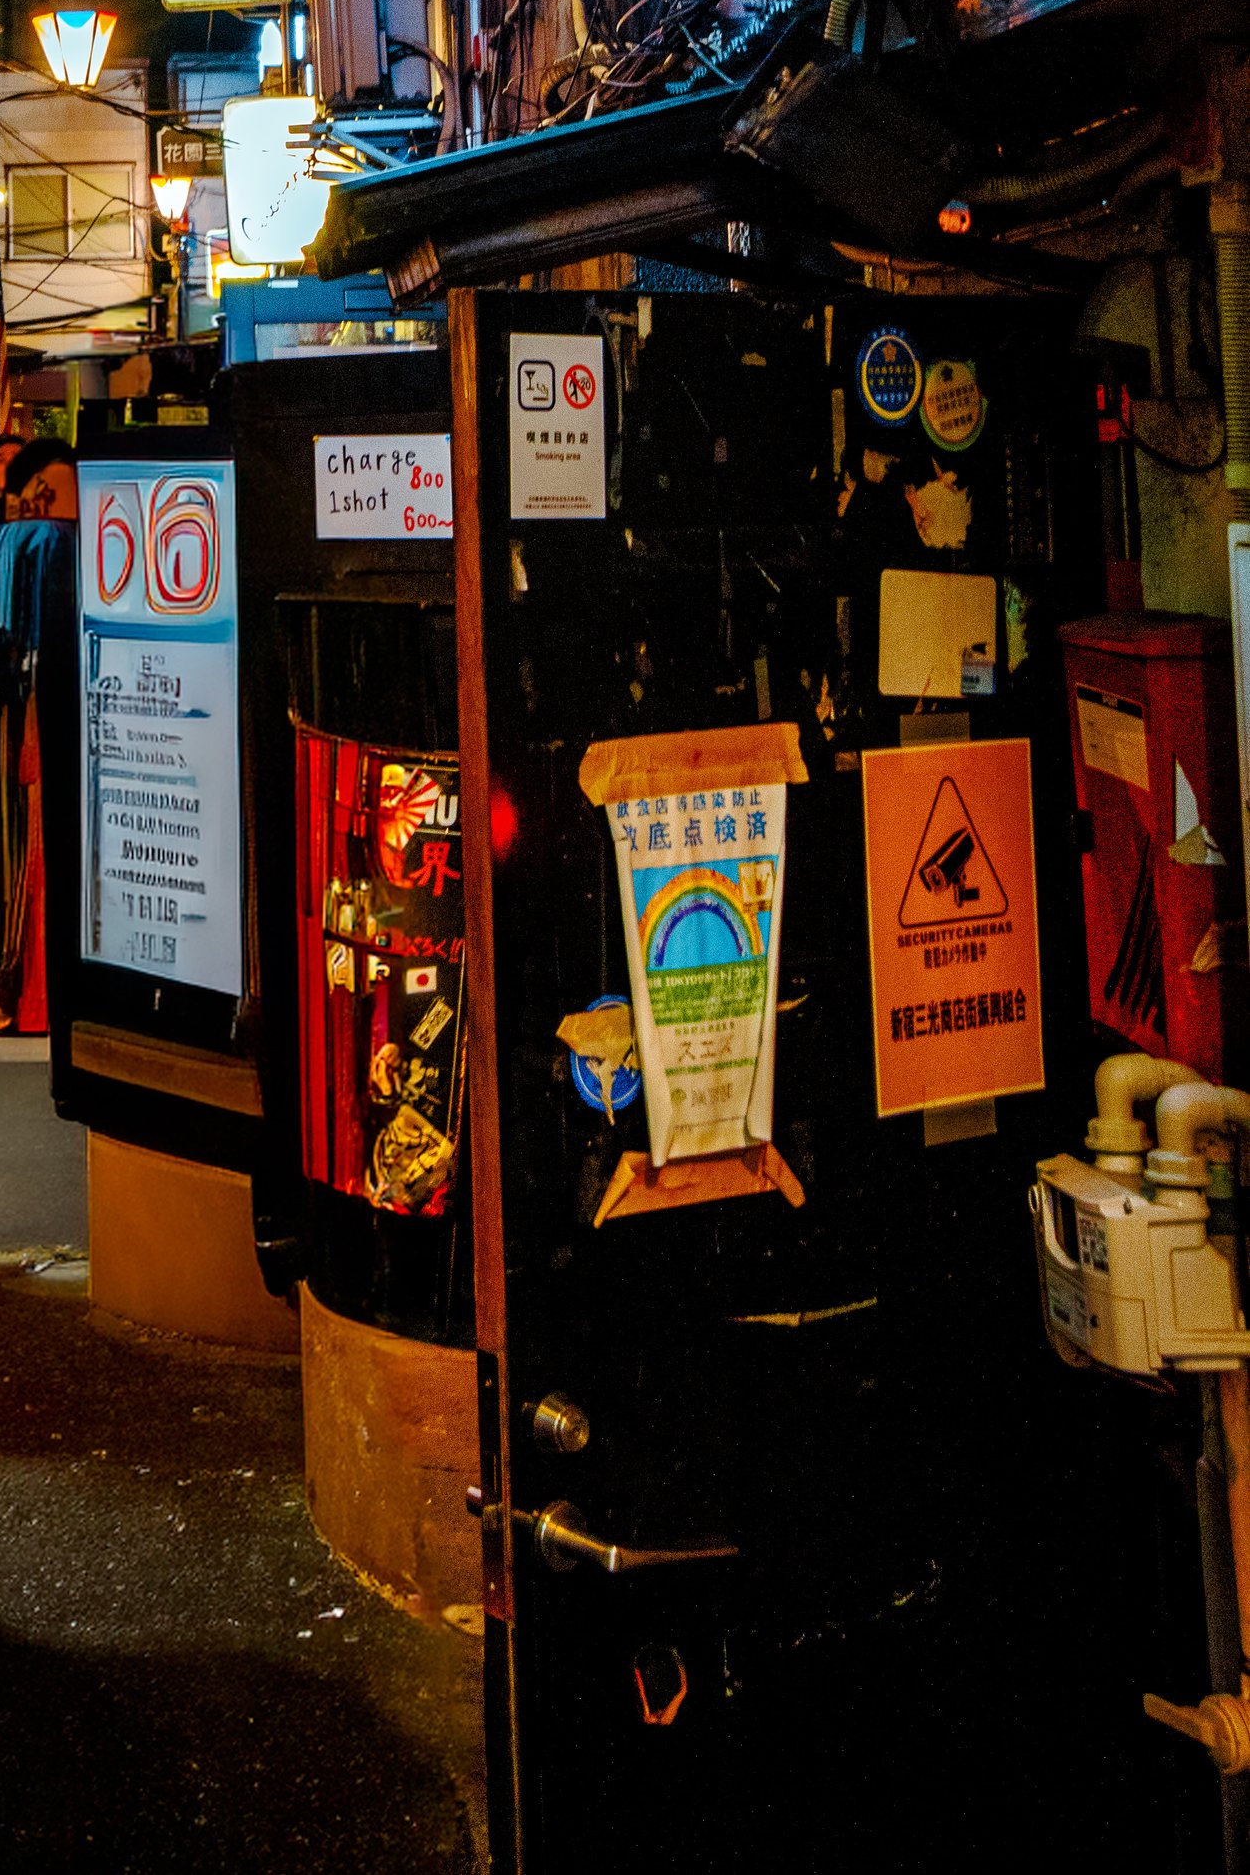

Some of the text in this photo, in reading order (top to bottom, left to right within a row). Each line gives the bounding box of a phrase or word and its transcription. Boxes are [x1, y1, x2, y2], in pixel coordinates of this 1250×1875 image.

[526, 431, 589, 445] 喫煙目的店
[326, 445, 445, 491] charge 800
[535, 451, 581, 462] Smoking area
[328, 488, 390, 516] 1shot
[616, 789, 763, 819] 飲食店等感染防止
[407, 841, 461, 898] 界
[897, 921, 1014, 948] SECURITY CAMERAS
[890, 987, 1028, 1043] 新宿三光商店街振興組合
